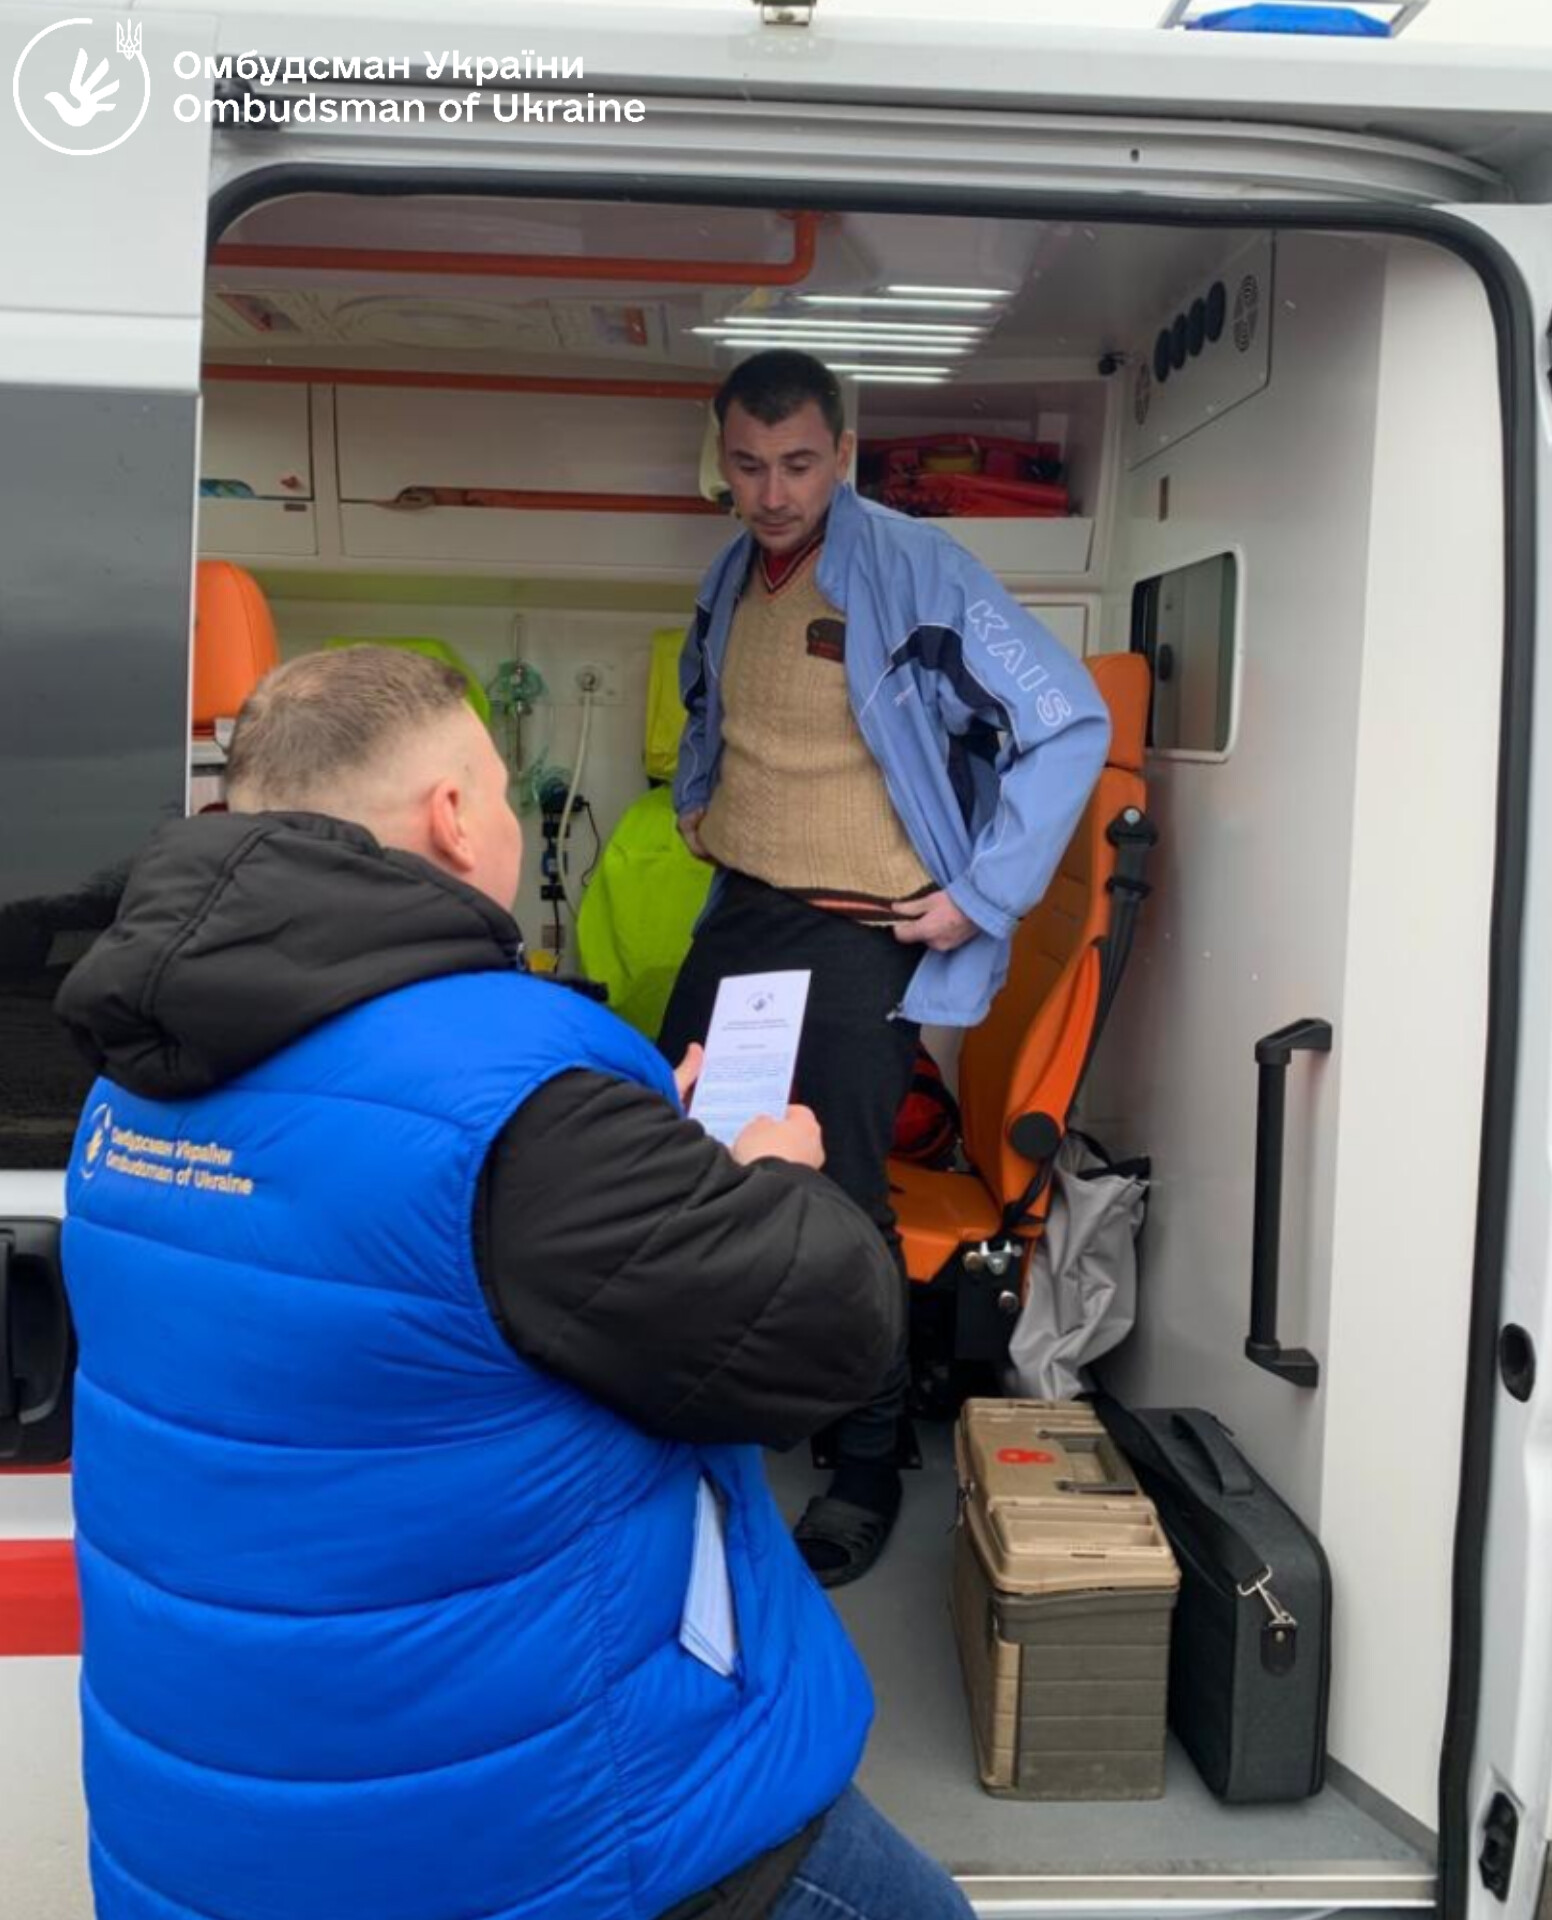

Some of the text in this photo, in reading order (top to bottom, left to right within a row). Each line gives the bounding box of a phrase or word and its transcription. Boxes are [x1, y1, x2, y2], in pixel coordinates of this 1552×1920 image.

[966, 599, 1072, 727] KAIS
[176, 1165, 192, 1185] of
[194, 1171, 254, 1194] Ukraine
